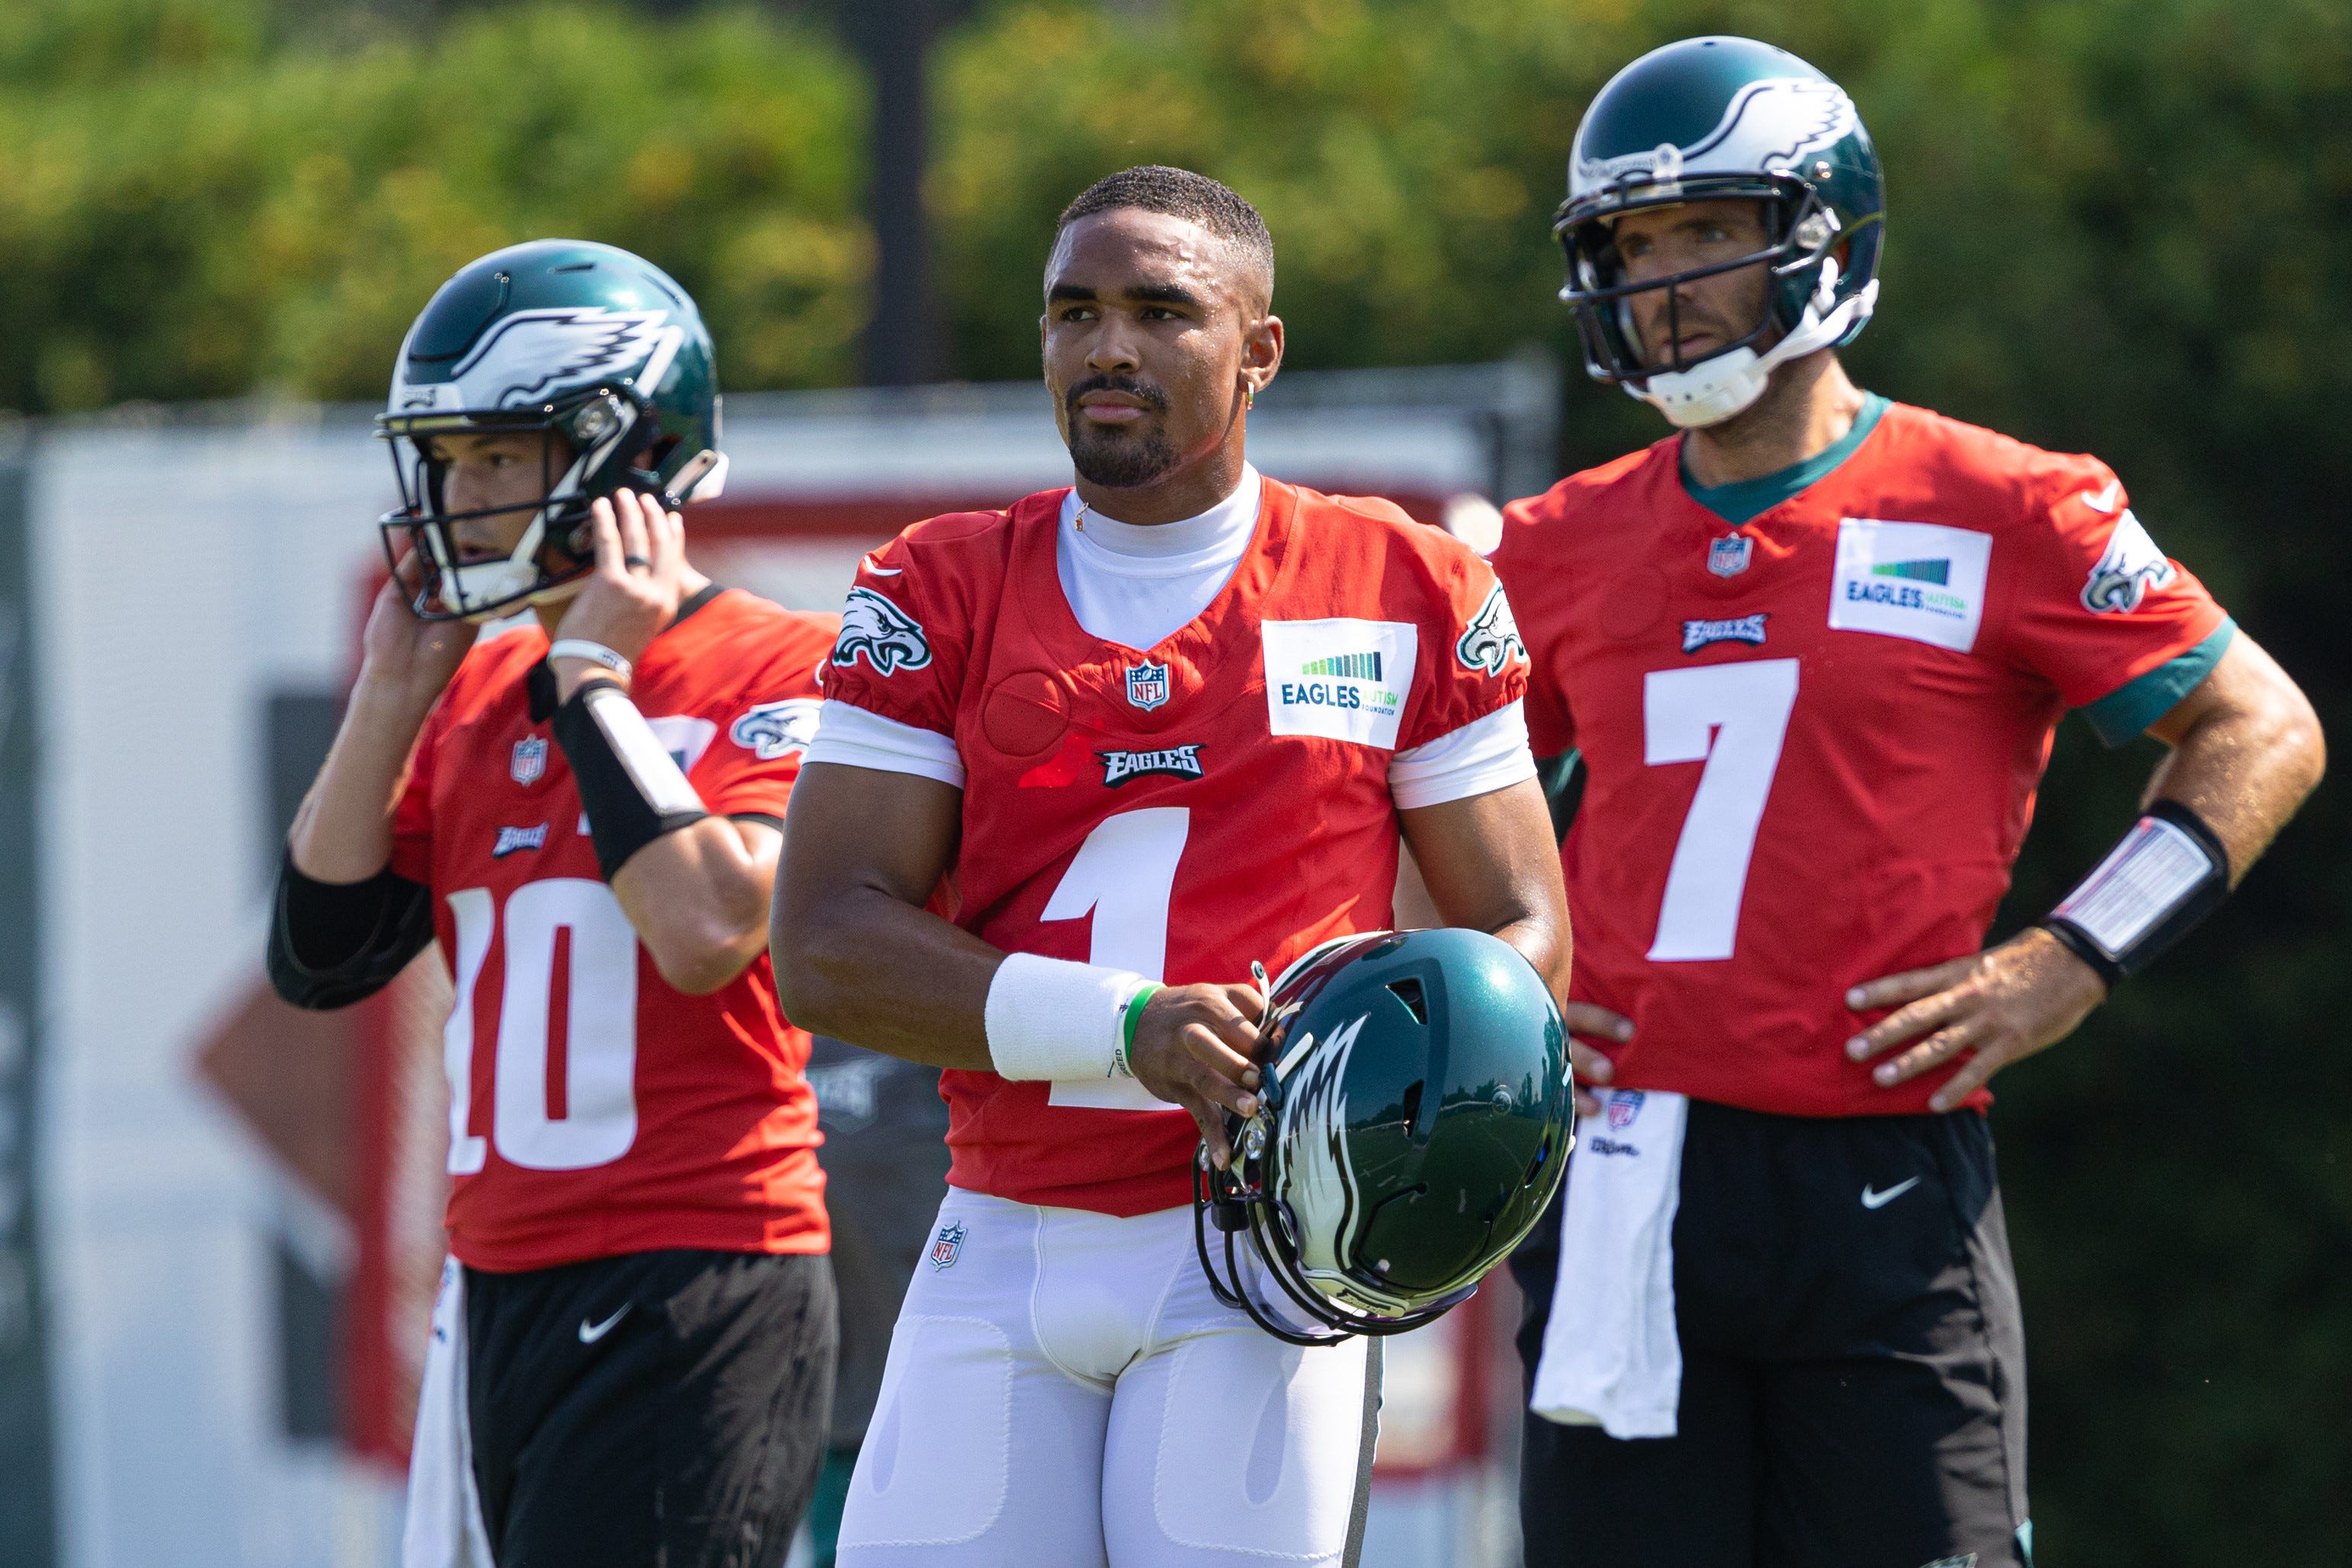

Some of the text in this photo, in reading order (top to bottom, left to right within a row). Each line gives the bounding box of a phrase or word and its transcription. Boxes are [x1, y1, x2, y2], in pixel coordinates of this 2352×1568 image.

[1846, 581, 1924, 608] EAGLES
[1133, 682, 1162, 701] NFL
[1281, 683, 1398, 709] EAGLES AUTISM
[1362, 704, 1395, 716] FOUNDATION
[1101, 744, 1206, 787] EAGLES
[1644, 657, 1801, 962] 7
[1040, 806, 1190, 1111] 1
[443, 877, 639, 1174] 10
[933, 1241, 954, 1262] NFL
